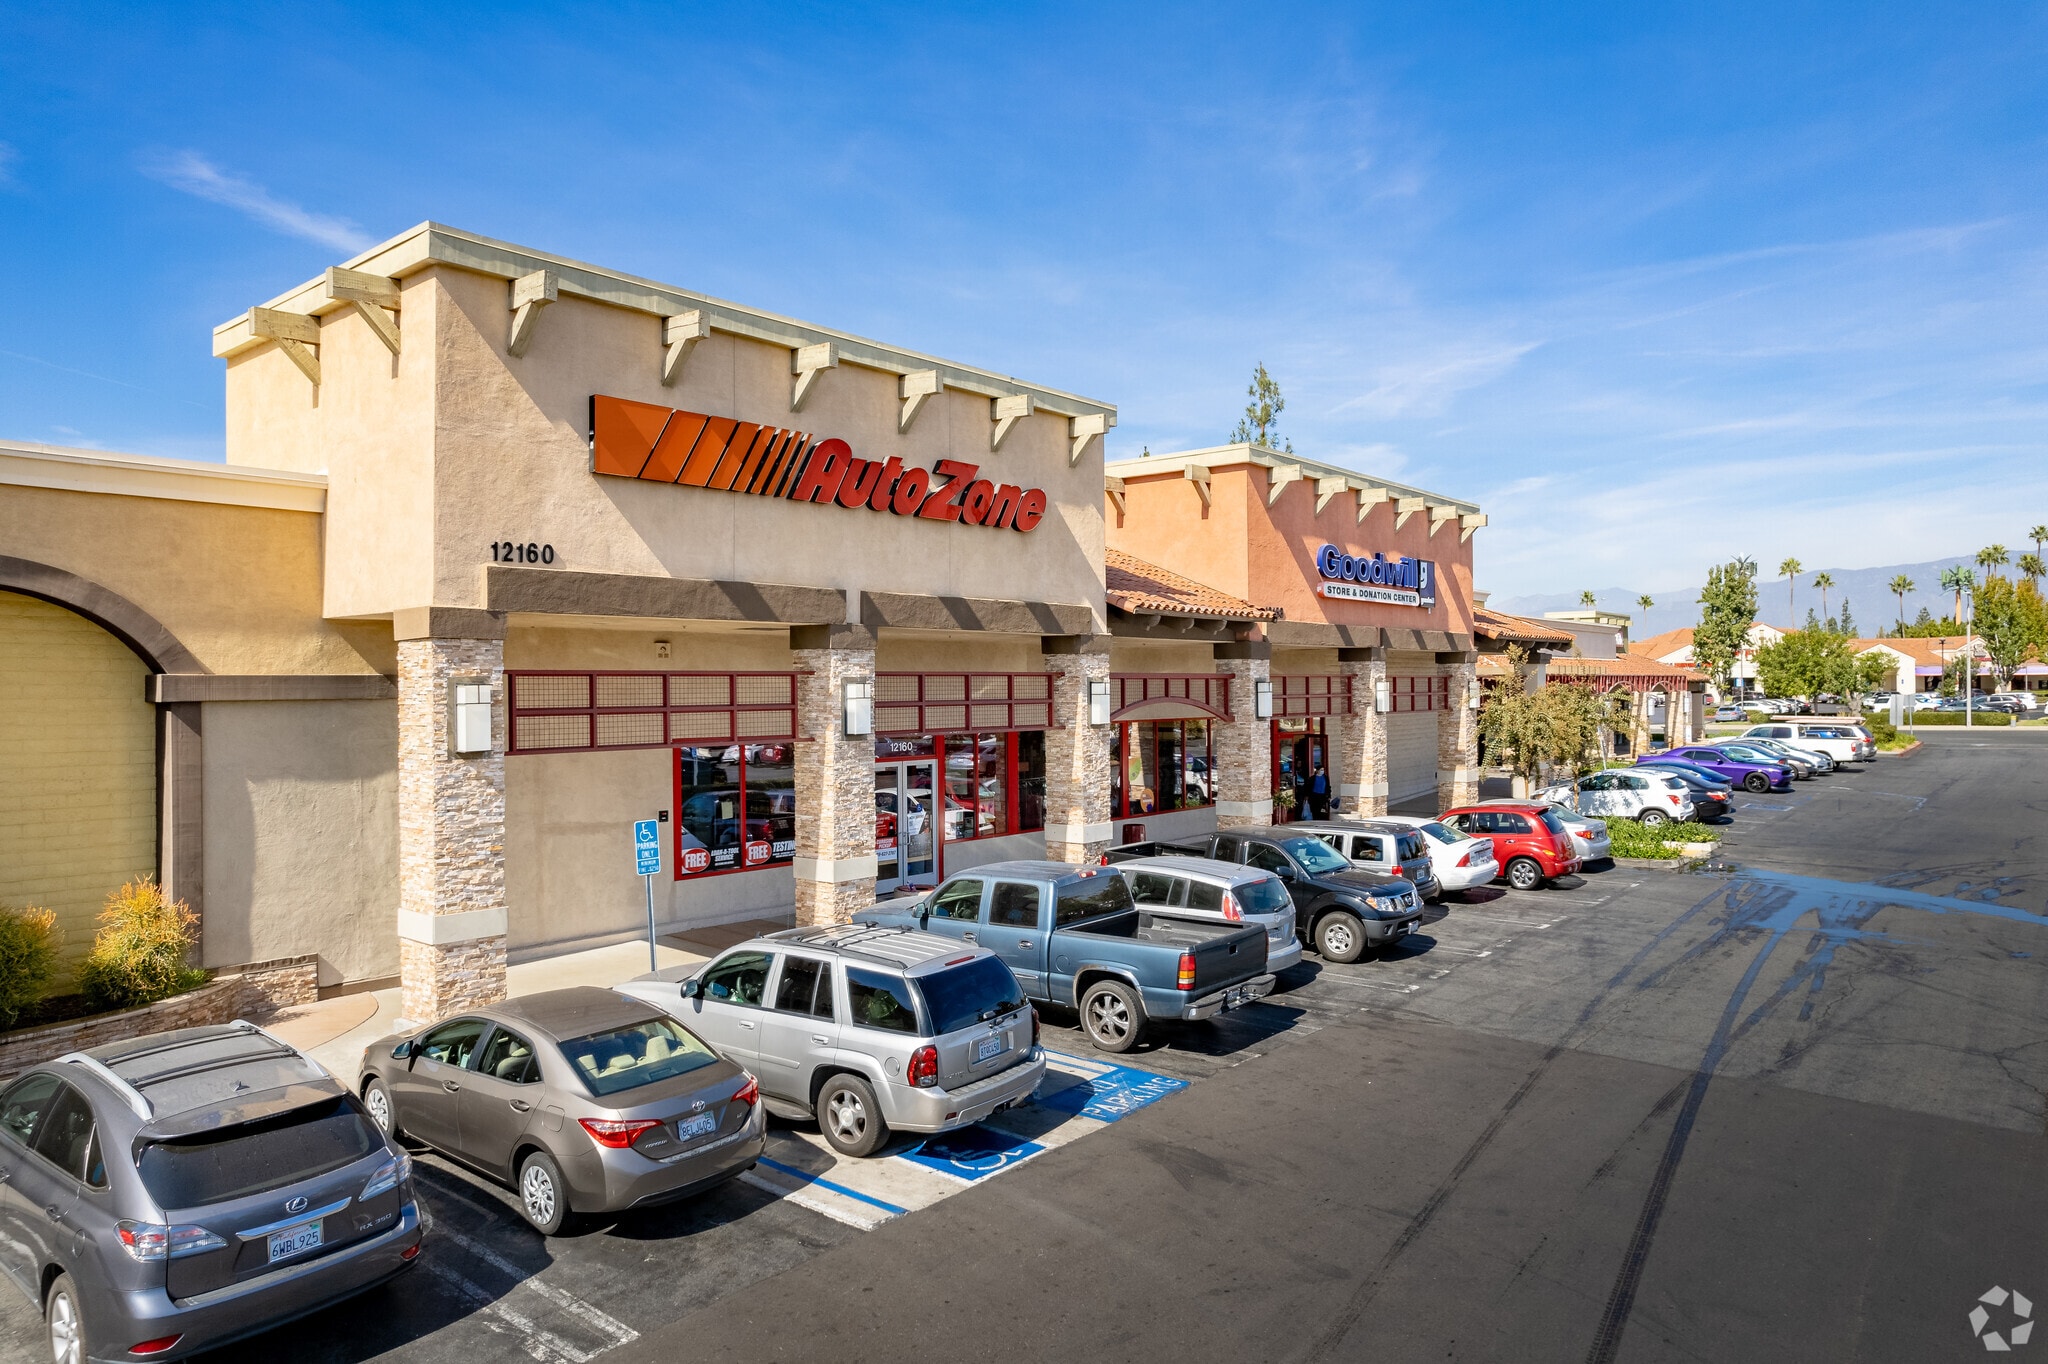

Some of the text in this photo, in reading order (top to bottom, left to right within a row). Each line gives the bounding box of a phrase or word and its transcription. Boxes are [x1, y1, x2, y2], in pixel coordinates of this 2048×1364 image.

[787, 438, 1047, 532] AutoZone
[491, 541, 554, 564] 12160
[1317, 543, 1418, 588] Goodwill
[1327, 585, 1350, 596] STORE
[1352, 588, 1357, 597] &
[1359, 589, 1392, 601] DONATION
[1393, 593, 1417, 604] CENTER
[890, 741, 913, 752] 12160
[637, 840, 658, 850] PARKING
[748, 844, 769, 861] FREE
[641, 850, 655, 859] ONLY
[685, 852, 707, 869] FREE
[1081, 1077, 1182, 1118] PARKING
[360, 1221, 373, 1231] RX
[272, 1231, 319, 1257] 6WBL925
